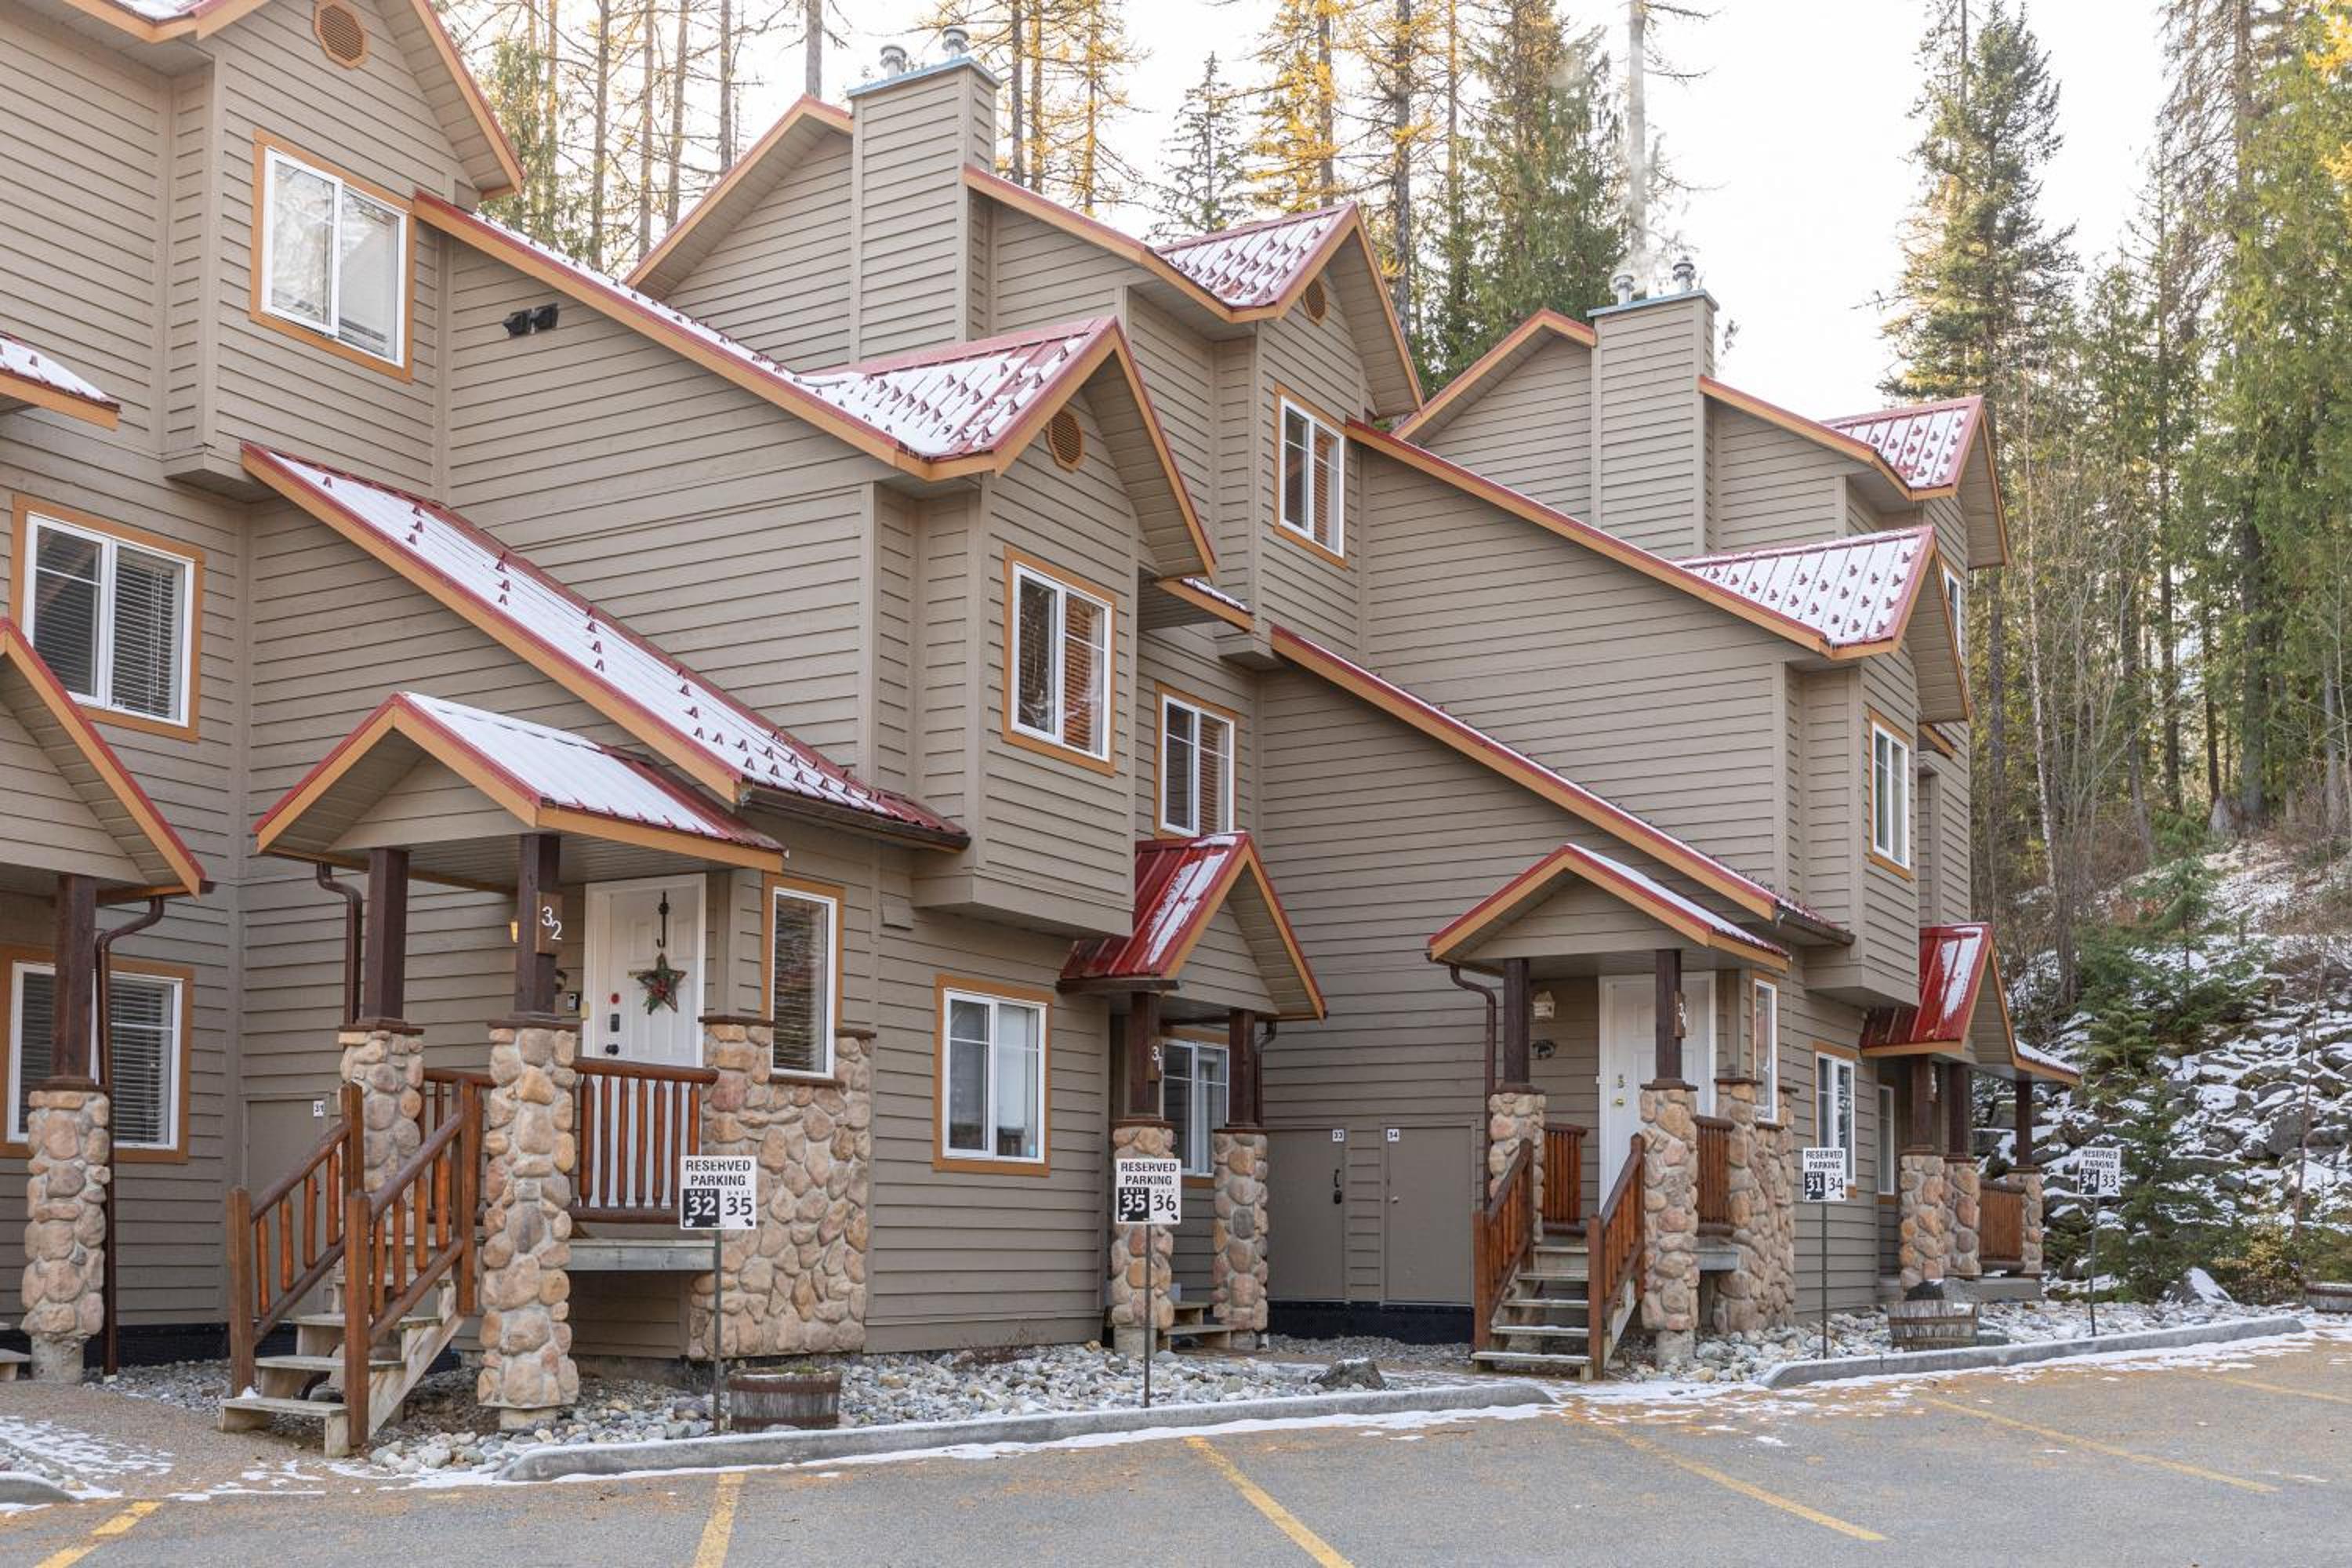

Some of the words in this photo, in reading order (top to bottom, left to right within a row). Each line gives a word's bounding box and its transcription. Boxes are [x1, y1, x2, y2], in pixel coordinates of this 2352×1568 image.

[542, 906, 562, 940] 32
[1806, 1150, 1843, 1159] RESERVED
[2082, 1150, 2118, 1159] RESERVED
[686, 1160, 750, 1171] RESERVED
[1121, 1162, 1177, 1172] RESERVED
[2085, 1160, 2114, 1169] PARKING
[691, 1175, 746, 1186] PARKING
[1125, 1175, 1172, 1185] PARKING
[1806, 1178, 1823, 1192] 31
[1828, 1177, 1844, 1191] 34
[2082, 1174, 2097, 1188] 34
[2101, 1174, 2116, 1188] 33
[688, 1196, 716, 1217] 32
[725, 1196, 753, 1216] 35
[1122, 1194, 1146, 1213] 35
[1153, 1194, 1177, 1211] 36
